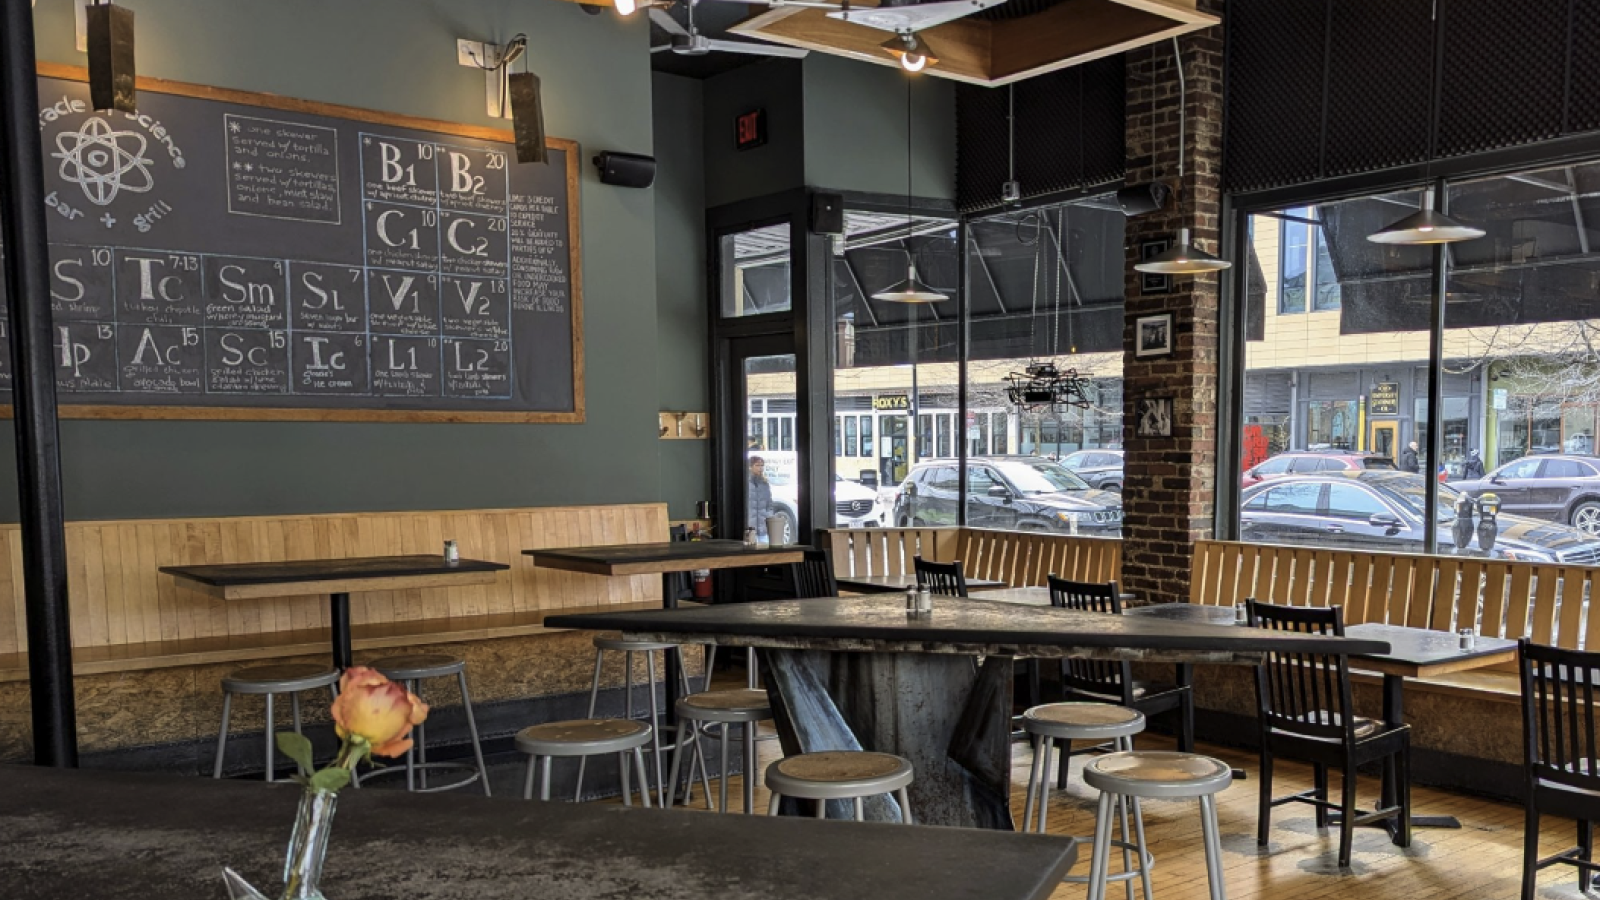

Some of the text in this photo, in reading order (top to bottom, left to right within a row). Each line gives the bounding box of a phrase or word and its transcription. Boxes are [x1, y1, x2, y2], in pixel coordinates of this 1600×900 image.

[276, 128, 318, 140] skewer
[234, 146, 258, 156] and
[418, 143, 433, 160] 10
[485, 153, 504, 169] 20
[238, 193, 259, 203] and
[267, 194, 294, 207] bean
[44, 190, 85, 220] bar
[133, 199, 172, 232] grill
[421, 211, 436, 228] 10
[487, 218, 506, 231] 20
[91, 248, 110, 266] 10
[273, 261, 283, 275] 9
[349, 269, 360, 283] 7
[427, 275, 437, 291] 9
[491, 280, 505, 294] 18
[97, 324, 113, 339] 13
[182, 327, 199, 346] 15
[269, 329, 285, 348] 15
[354, 335, 362, 347] 6
[427, 338, 437, 348] 10
